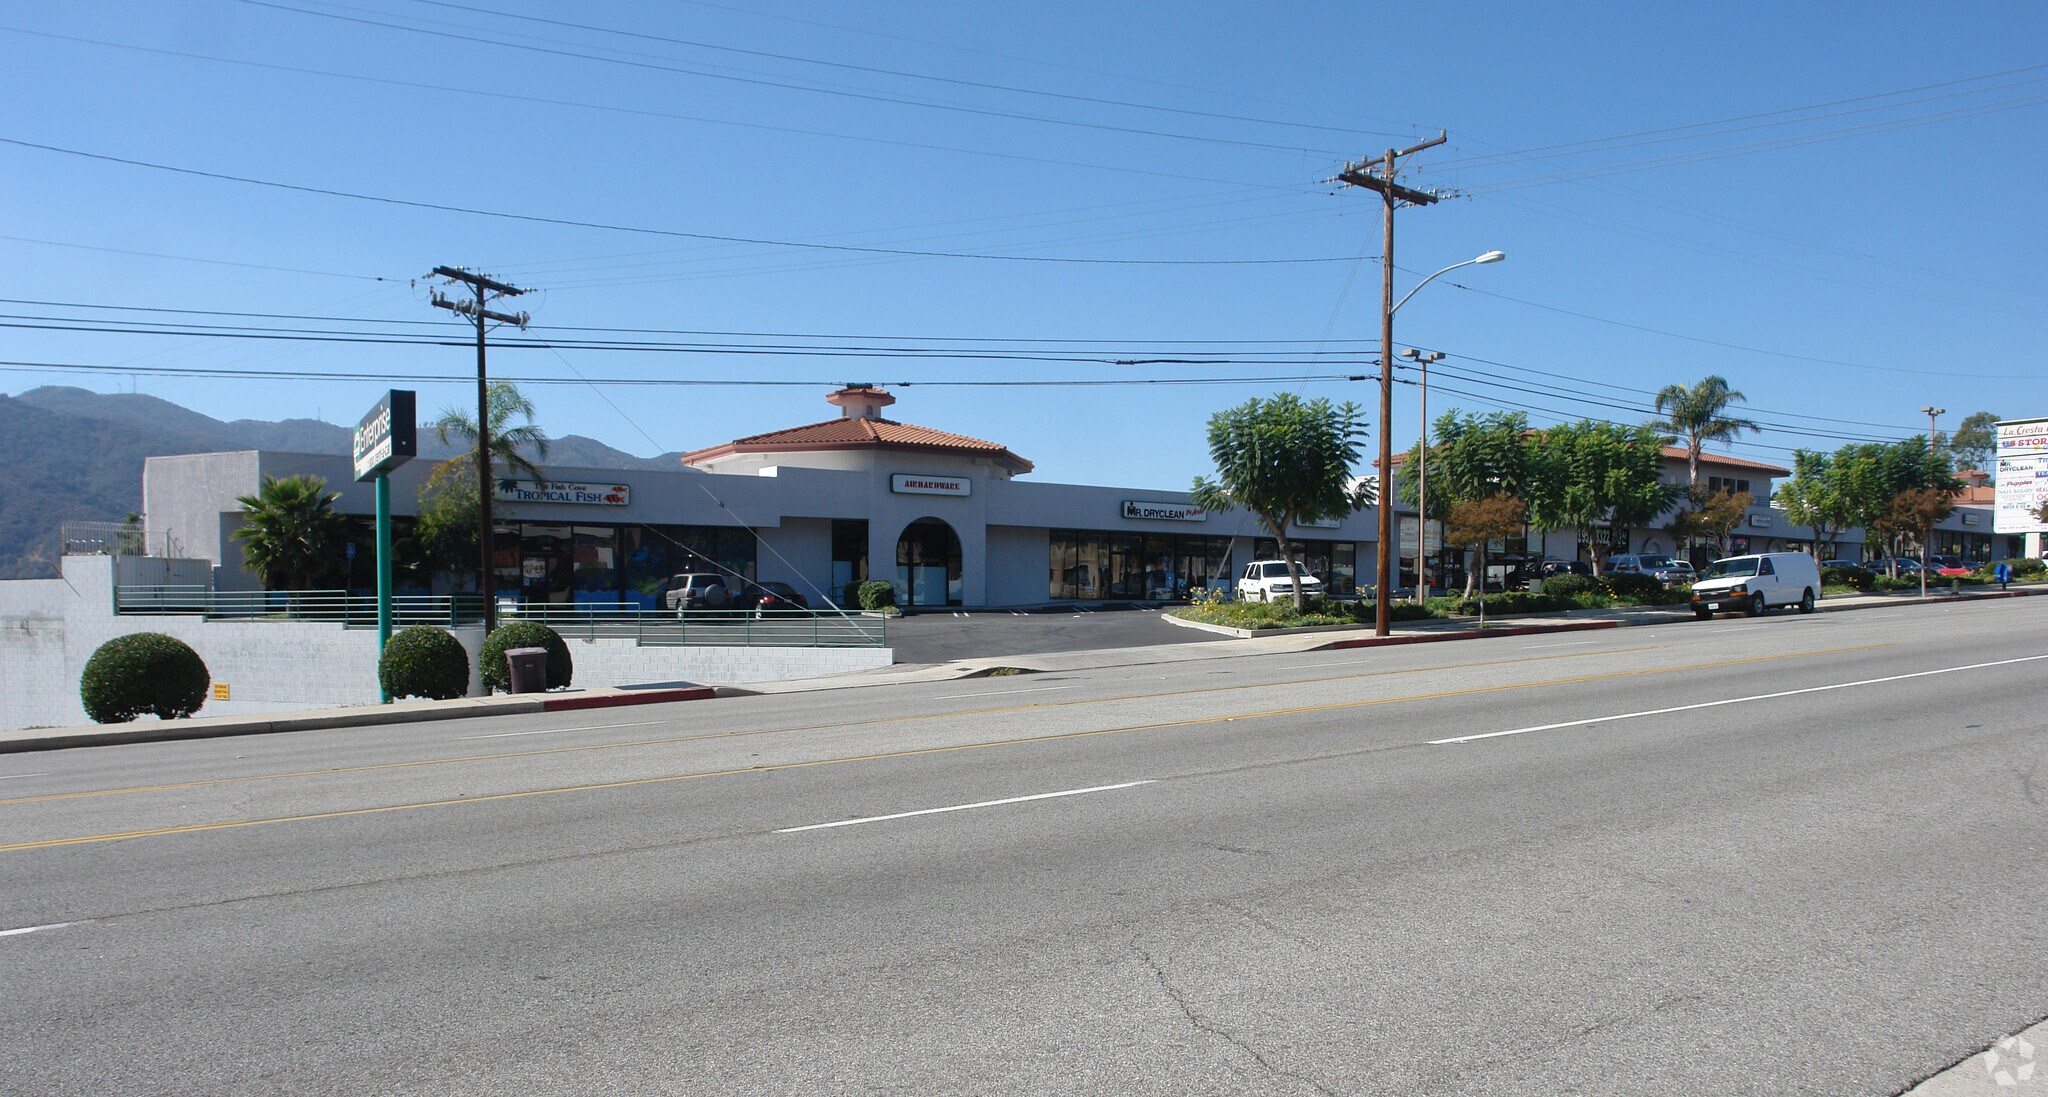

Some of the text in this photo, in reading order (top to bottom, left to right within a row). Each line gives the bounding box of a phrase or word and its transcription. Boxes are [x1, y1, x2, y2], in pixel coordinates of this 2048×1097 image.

[360, 405, 391, 453] Enterprise
[1999, 465, 2034, 473] DRYCLEAN
[550, 483, 566, 491] Fish
[515, 489, 602, 502] TROPICAL FISH
[1144, 508, 1185, 519] DRYCLEAN
